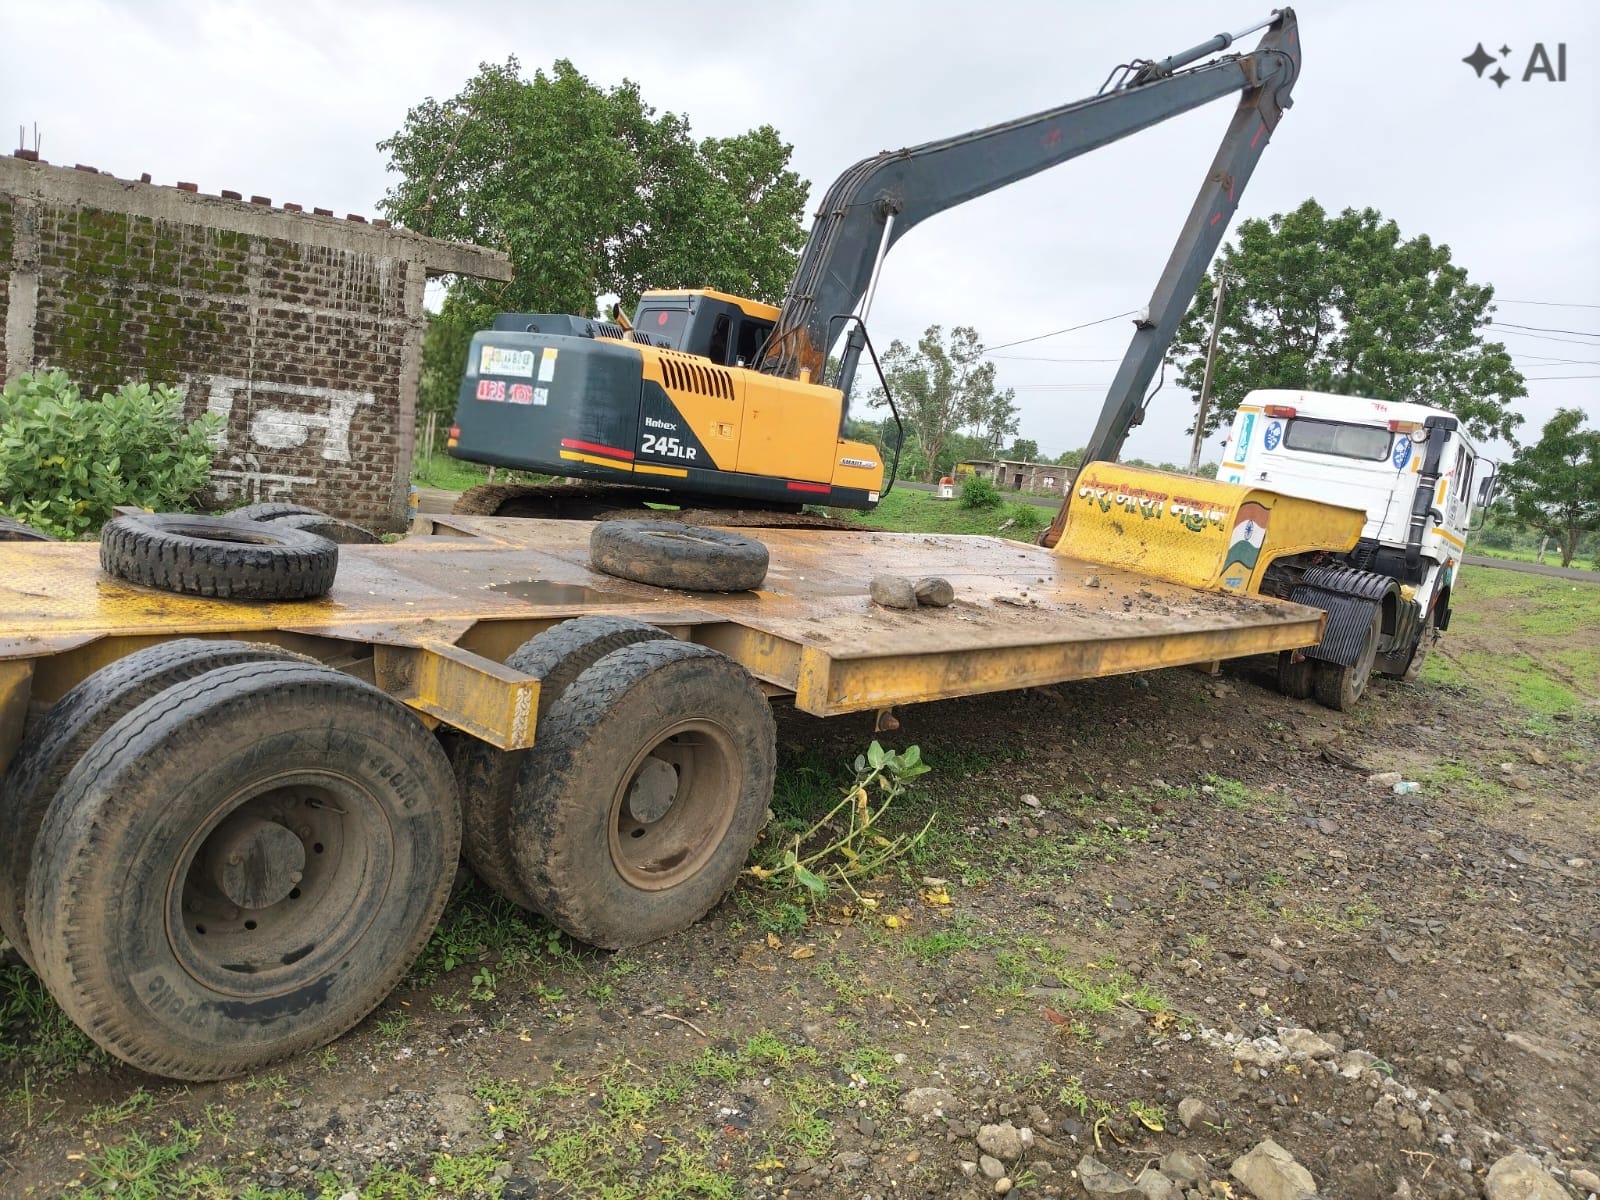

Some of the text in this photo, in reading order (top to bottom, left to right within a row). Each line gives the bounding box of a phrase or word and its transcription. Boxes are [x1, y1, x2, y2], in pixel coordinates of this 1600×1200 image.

[645, 416, 677, 431] Robex
[641, 433, 697, 460] 245LR
[1116, 483, 1169, 520] भारत
